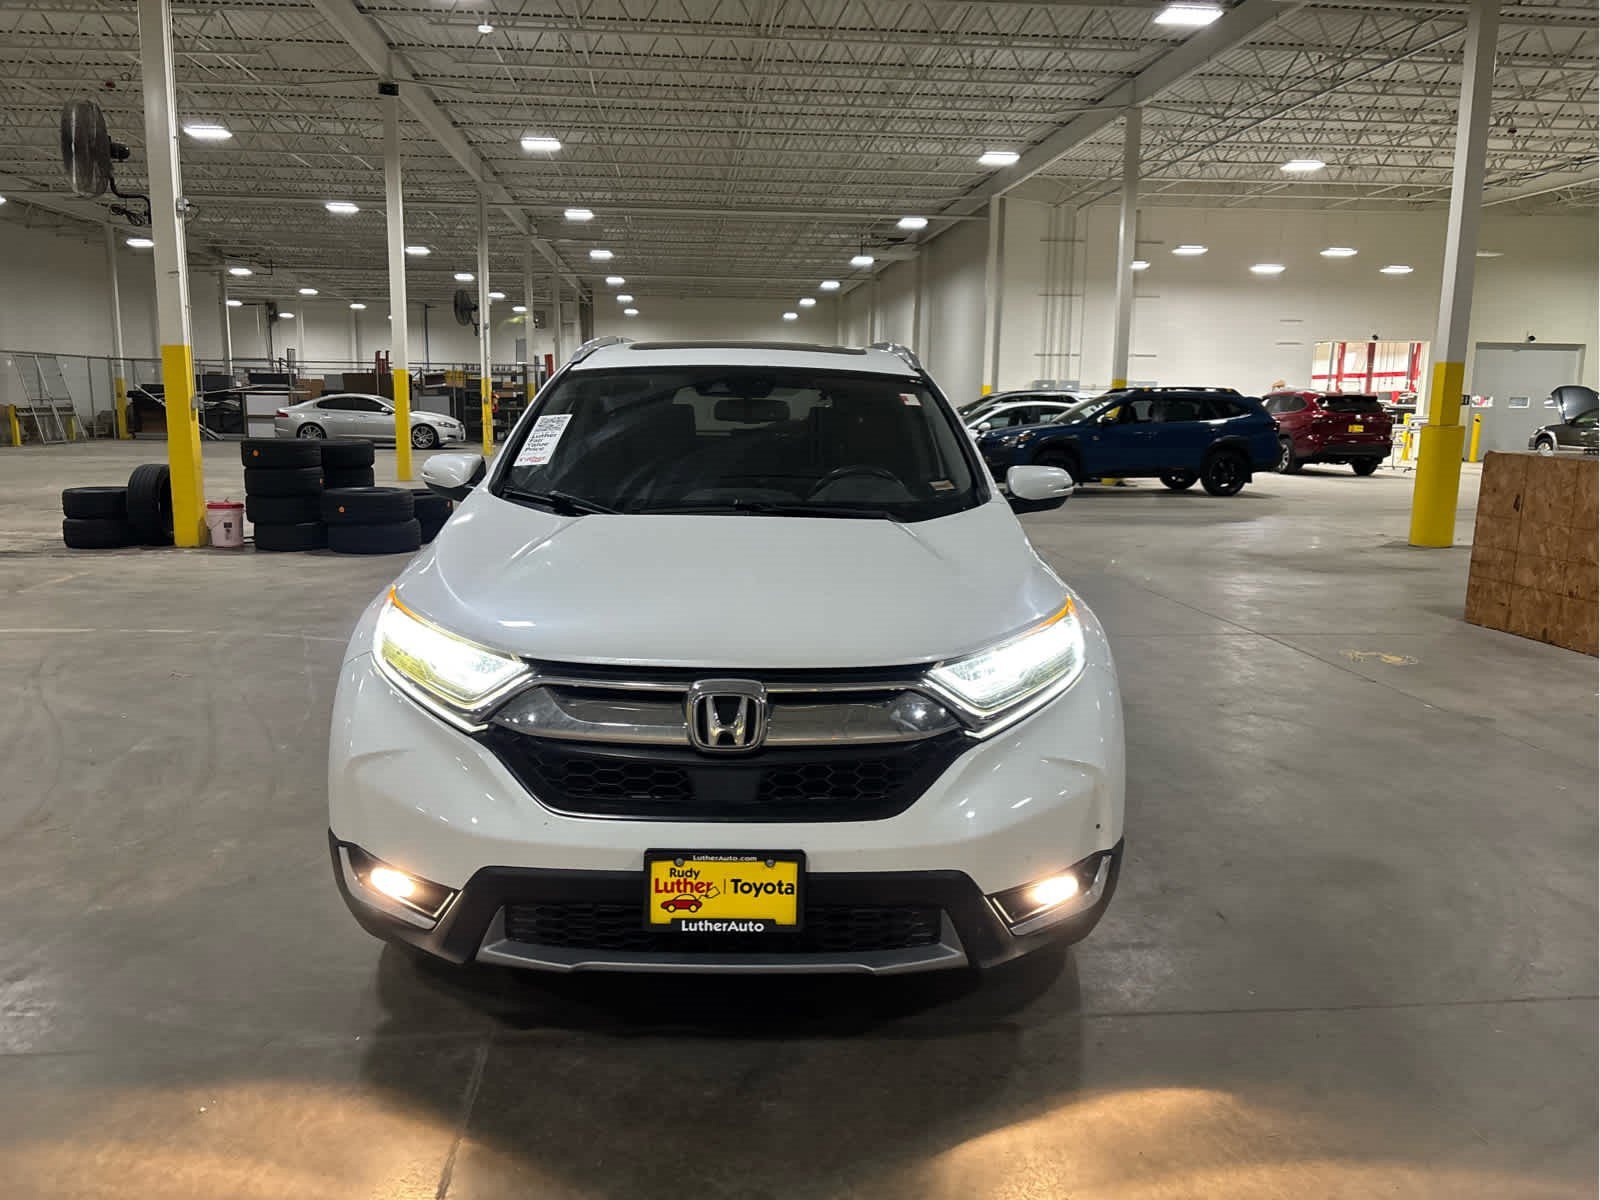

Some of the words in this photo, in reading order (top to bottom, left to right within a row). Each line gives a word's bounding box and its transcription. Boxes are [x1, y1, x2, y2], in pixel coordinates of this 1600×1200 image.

[669, 867, 701, 880] Rudy
[654, 877, 714, 894] Luther
[730, 878, 796, 898] Toyota
[681, 919, 765, 932] LutherAuto
